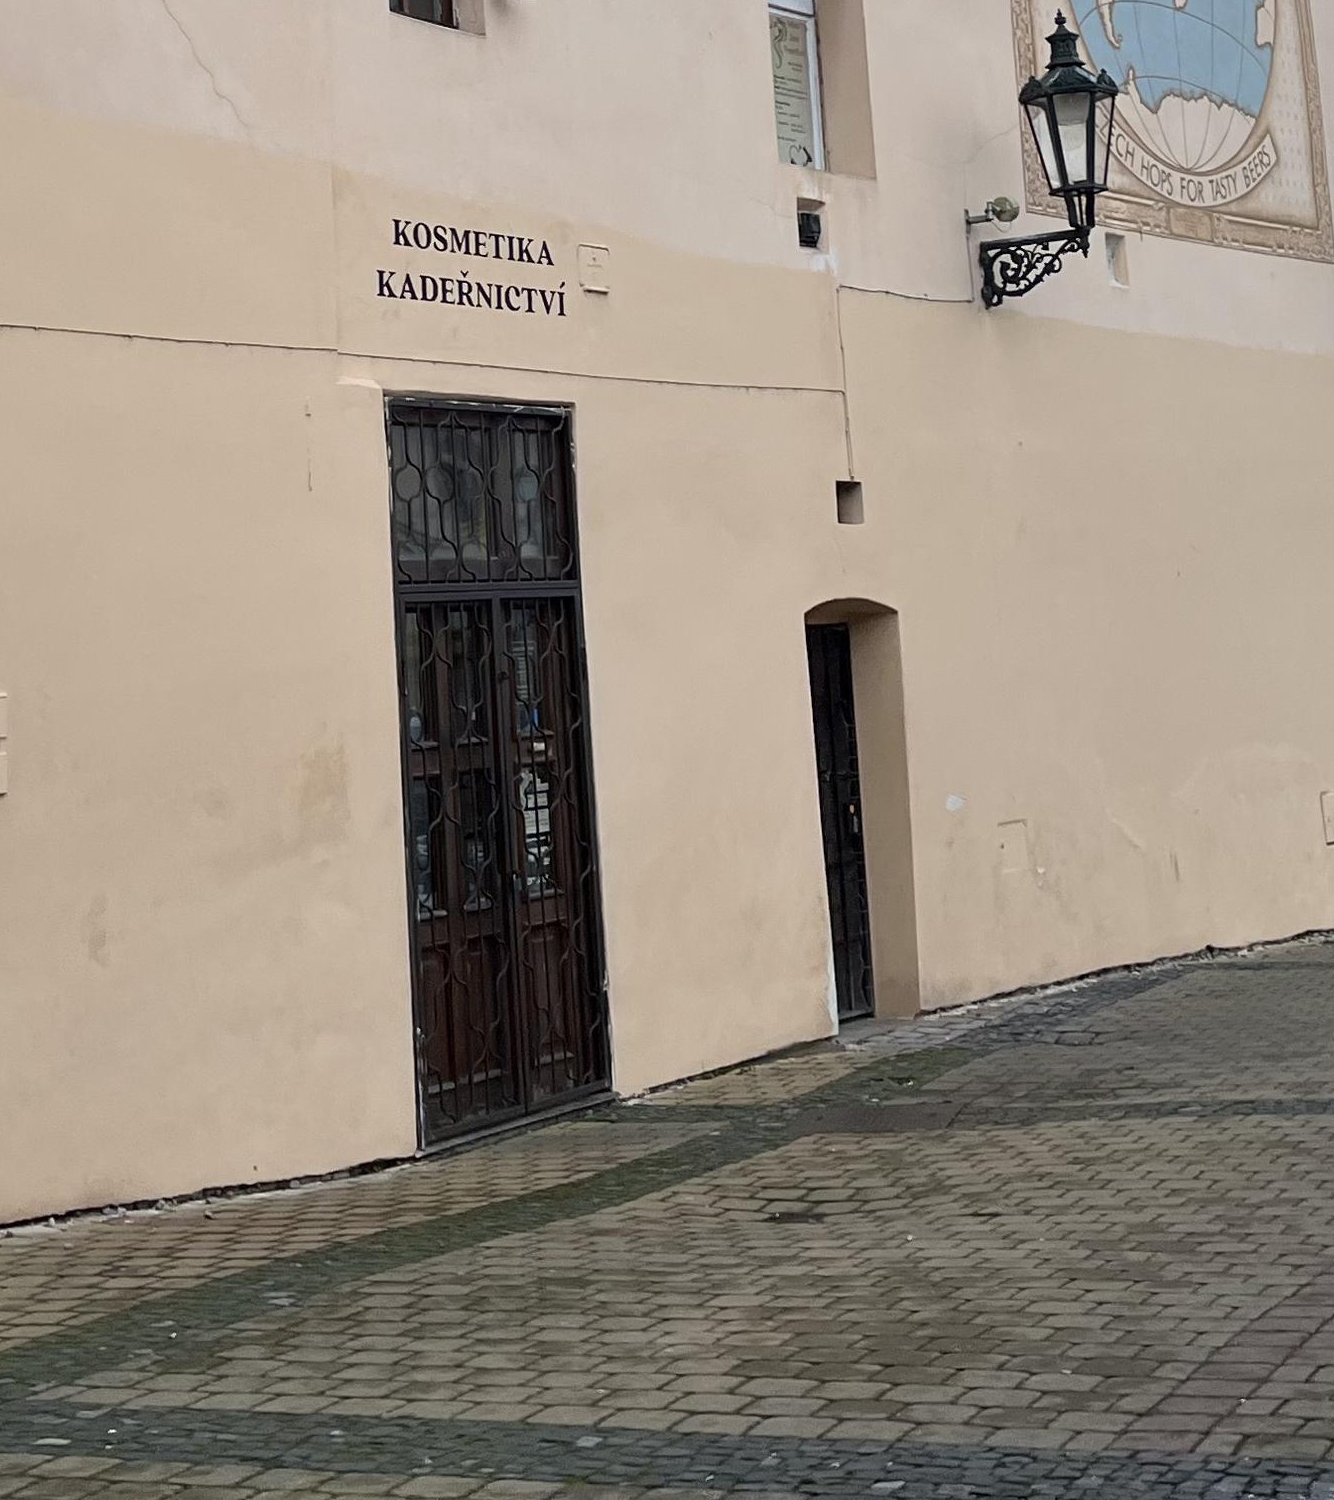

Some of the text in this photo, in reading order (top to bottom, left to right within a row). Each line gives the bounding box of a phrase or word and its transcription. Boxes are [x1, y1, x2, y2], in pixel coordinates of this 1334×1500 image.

[1140, 155, 1174, 197] HOPS
[1180, 176, 1205, 203] FOR
[1208, 171, 1238, 202] TASTY
[1242, 144, 1271, 189] BEERS
[392, 218, 555, 267] KOSMETIKA
[376, 270, 567, 317] KADEŘNICTVÍ
